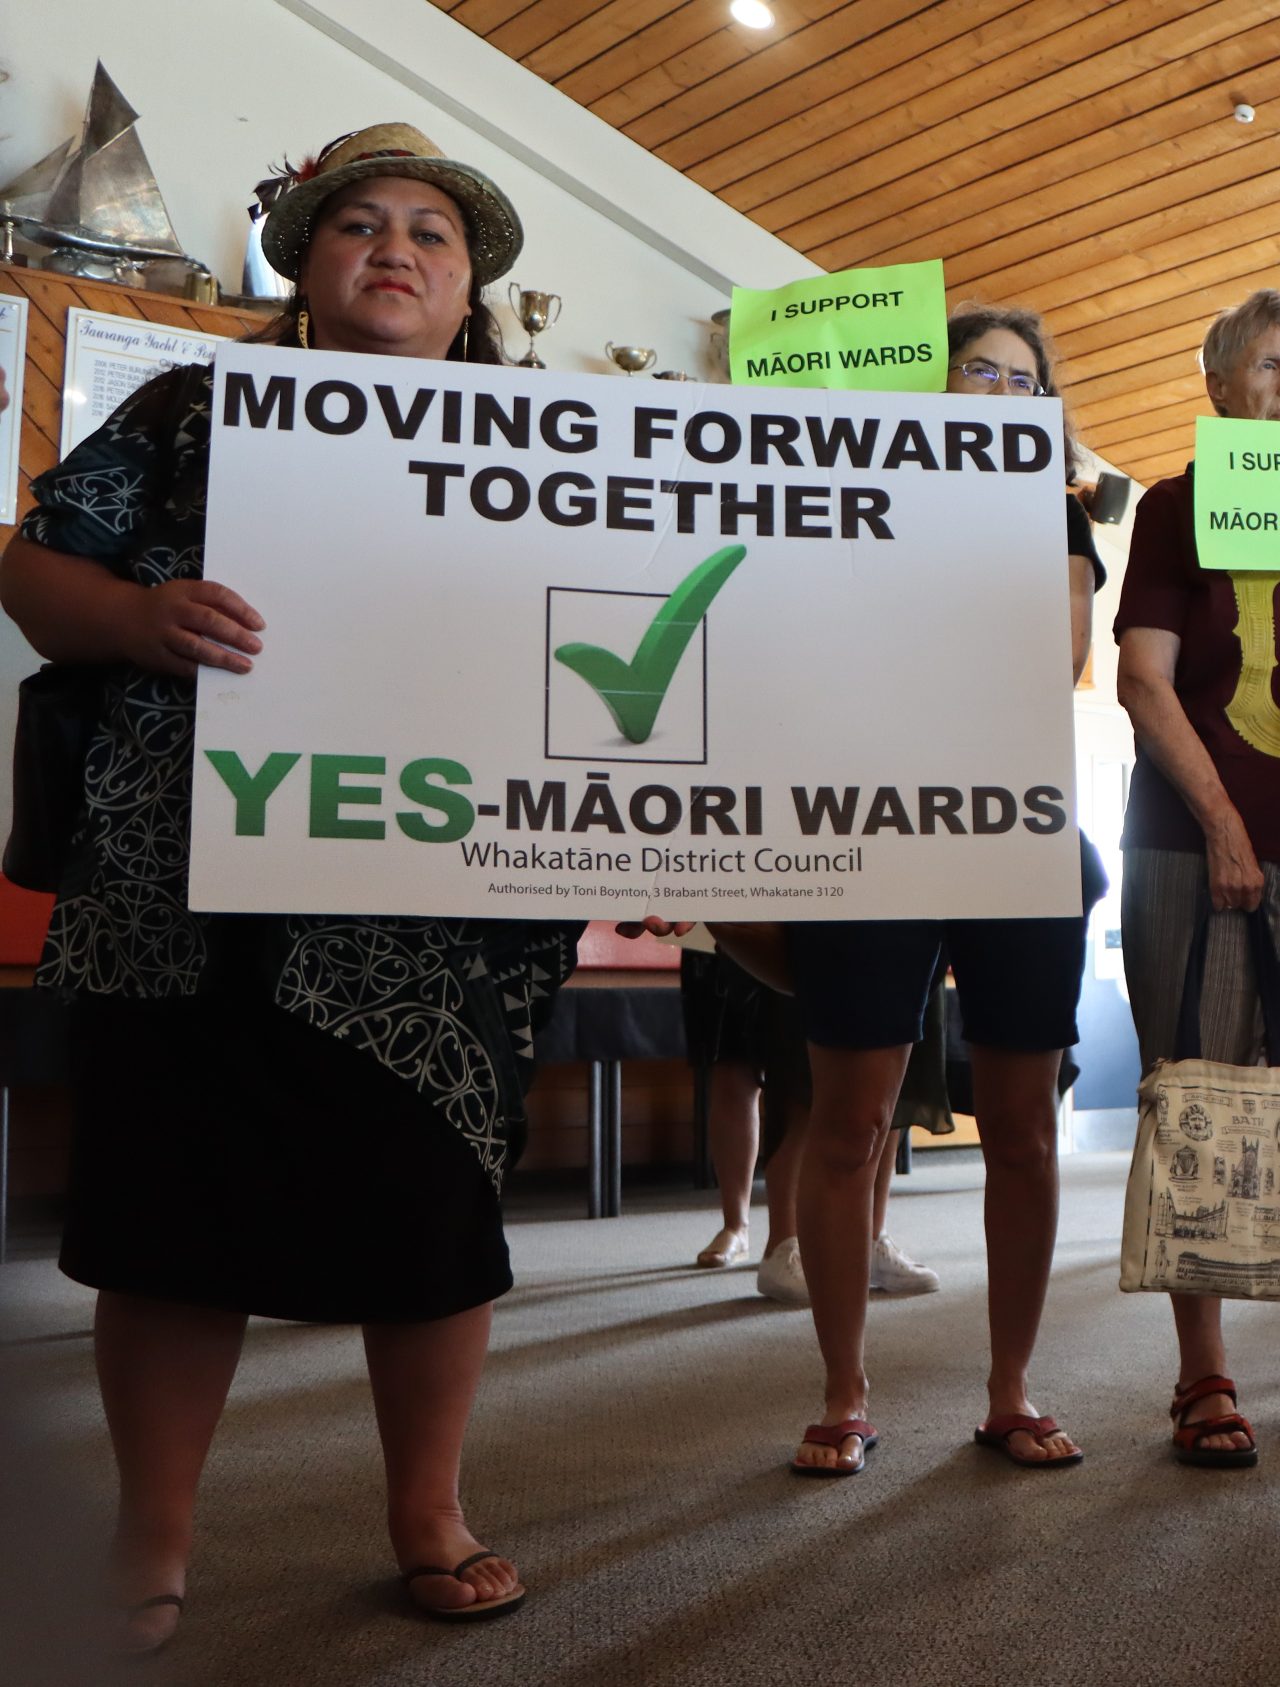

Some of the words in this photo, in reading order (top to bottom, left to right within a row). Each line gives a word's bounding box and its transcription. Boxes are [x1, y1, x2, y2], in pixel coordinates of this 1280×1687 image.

[770, 309, 777, 322] I
[784, 290, 904, 319] SUPPORT
[746, 351, 831, 378] MĀORI
[838, 343, 933, 369] WARDS
[223, 371, 598, 454] MOVING
[633, 405, 1053, 474] FORWARD
[1229, 451, 1235, 470] I
[408, 460, 895, 540] TOGETHER
[790, 785, 1067, 836] WARDS
[461, 842, 632, 872] Whakatāne
[641, 847, 745, 873] District
[755, 847, 863, 873] Council
[487, 883, 553, 896] Authorised
[555, 884, 570, 899] by
[573, 884, 597, 897] Toni
[600, 885, 651, 899] Boynton,
[653, 886, 660, 898] 3
[664, 885, 708, 898] Brabant
[711, 886, 748, 899] Street,
[750, 885, 813, 898] Whakatane
[816, 886, 844, 898] 3120
